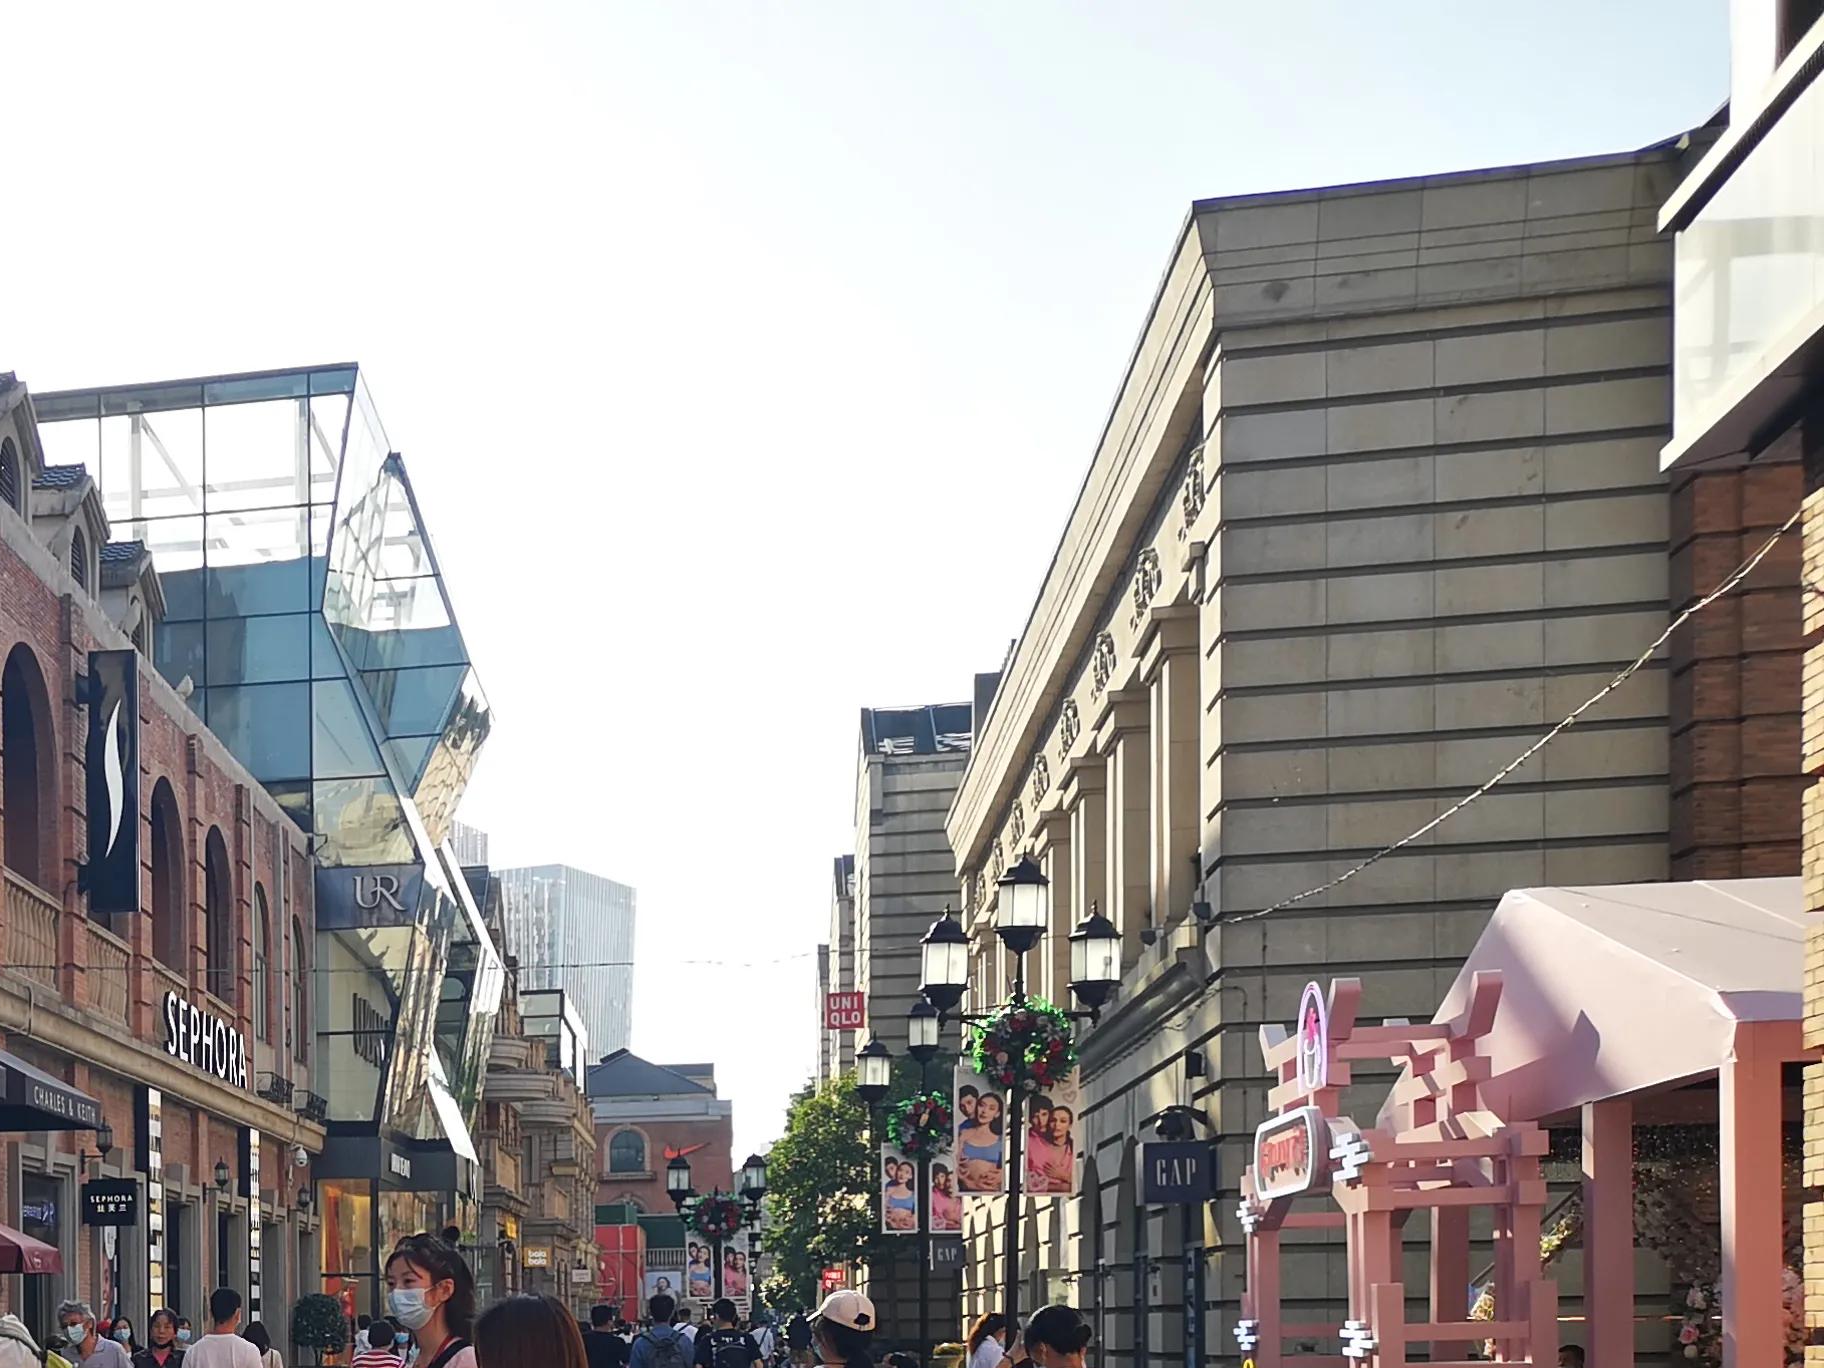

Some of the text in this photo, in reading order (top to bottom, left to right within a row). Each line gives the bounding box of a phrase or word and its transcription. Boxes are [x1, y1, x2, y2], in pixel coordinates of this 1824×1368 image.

[352, 875, 407, 912] UR
[830, 996, 858, 1010] UNI
[830, 1010, 861, 1027] QLO
[166, 990, 249, 1091] SEPHORA
[33, 1085, 97, 1123] CHARLES & KEITH
[1156, 1158, 1197, 1187] GAP
[89, 1194, 133, 1203] SEPHORA
